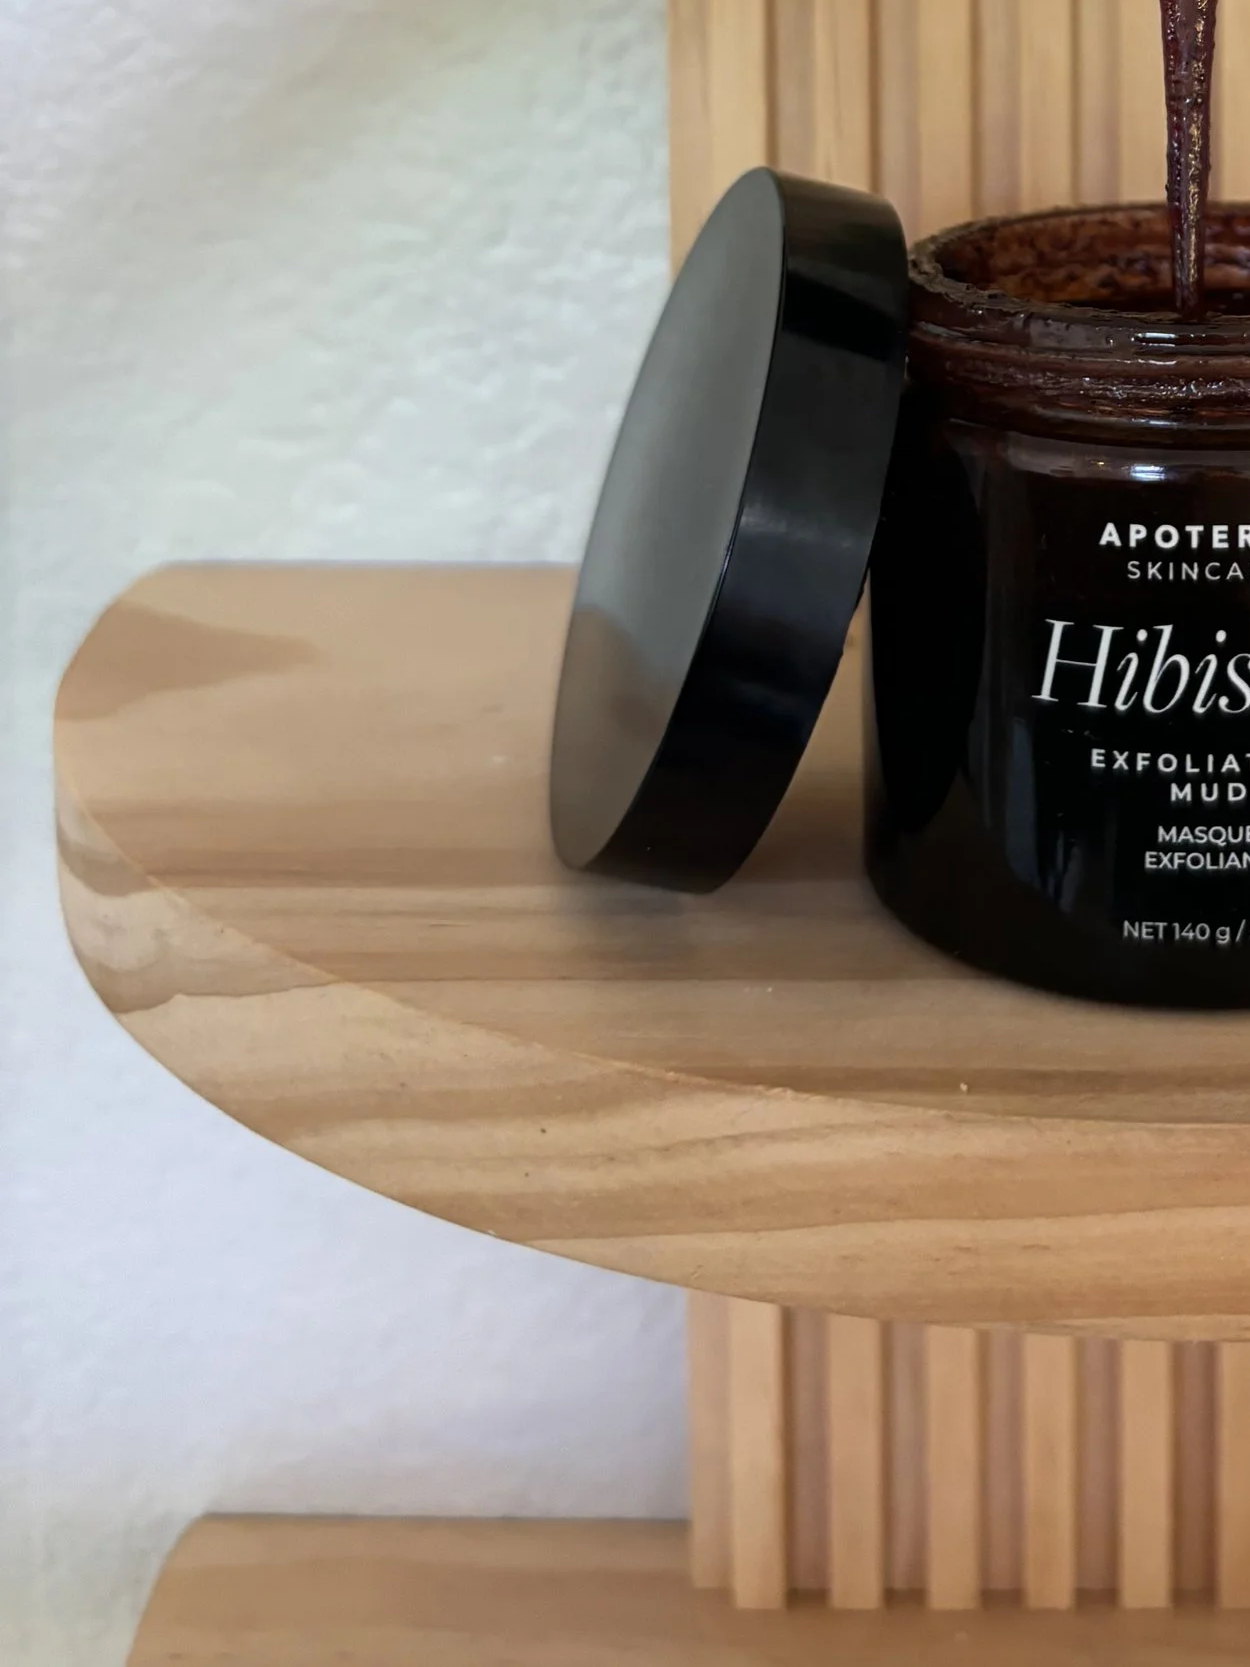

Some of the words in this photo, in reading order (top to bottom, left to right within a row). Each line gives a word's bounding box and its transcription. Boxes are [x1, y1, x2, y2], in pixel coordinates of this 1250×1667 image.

[1170, 782, 1248, 803] MUD
[1123, 920, 1168, 940] NET
[1172, 922, 1211, 941] 140
